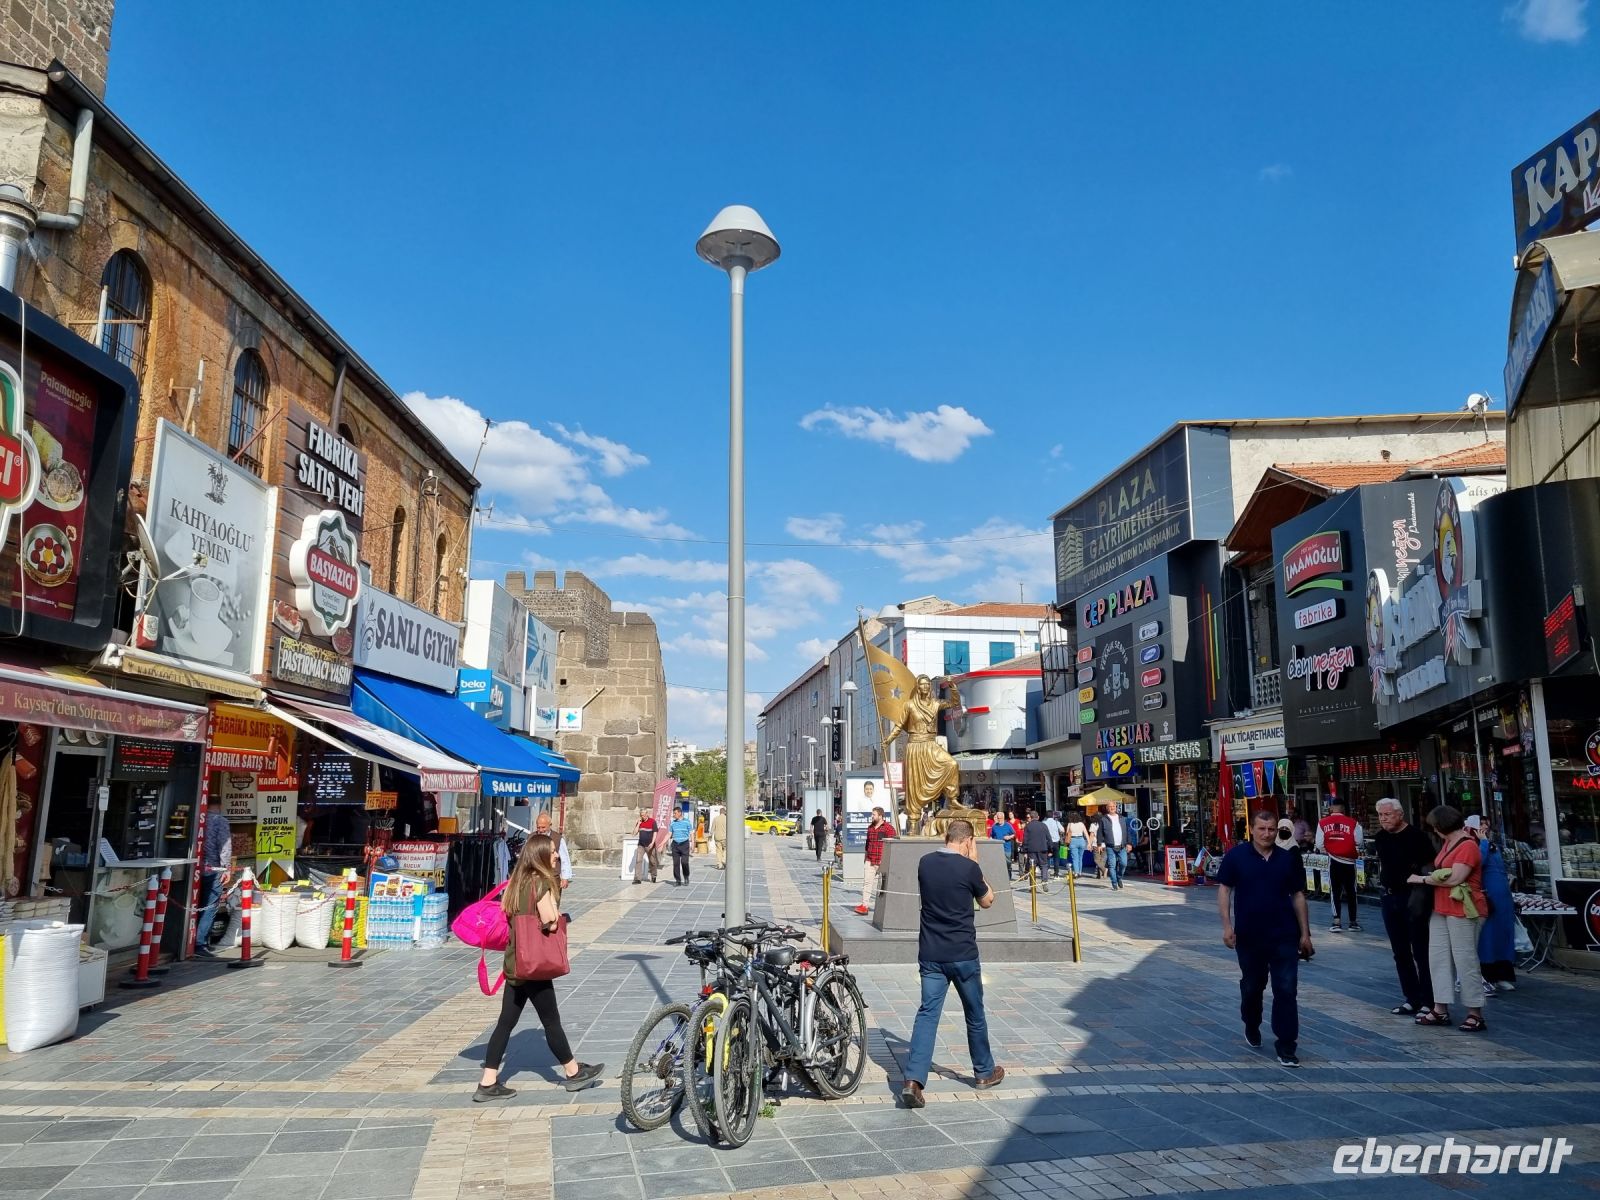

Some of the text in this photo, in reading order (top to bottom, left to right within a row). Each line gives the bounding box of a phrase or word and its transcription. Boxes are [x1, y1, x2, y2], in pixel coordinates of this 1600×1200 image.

[1524, 127, 1600, 227] KAP
[308, 421, 358, 480] FABRİKA
[299, 452, 363, 518] SATIŞ YERİ
[1098, 468, 1156, 521] PLAZA
[170, 498, 250, 553] KAHYAOĞLU
[1090, 495, 1169, 559] GAYRİMENKUL
[191, 533, 230, 565] YEMEN
[310, 553, 353, 592] BAŞYAZICI
[1083, 575, 1154, 629] CEP PLAZA
[1299, 606, 1333, 626] fabrika
[376, 607, 458, 669] ŞANLI GİYİM
[281, 649, 329, 681] PASTIRMACI
[461, 680, 486, 688] beko
[14, 692, 77, 717] Kayseri'den
[79, 704, 123, 724] Sofranıza
[1096, 722, 1151, 749] AKSESUAR
[242, 753, 263, 771] SATIŞ
[1139, 741, 1201, 763] TEKNİK SERVİS
[492, 780, 552, 794] ŞANLI GİYİM
[262, 817, 289, 825] SUCUK
[271, 806, 282, 814] ETİ
[392, 843, 435, 851] KAMPANYA
